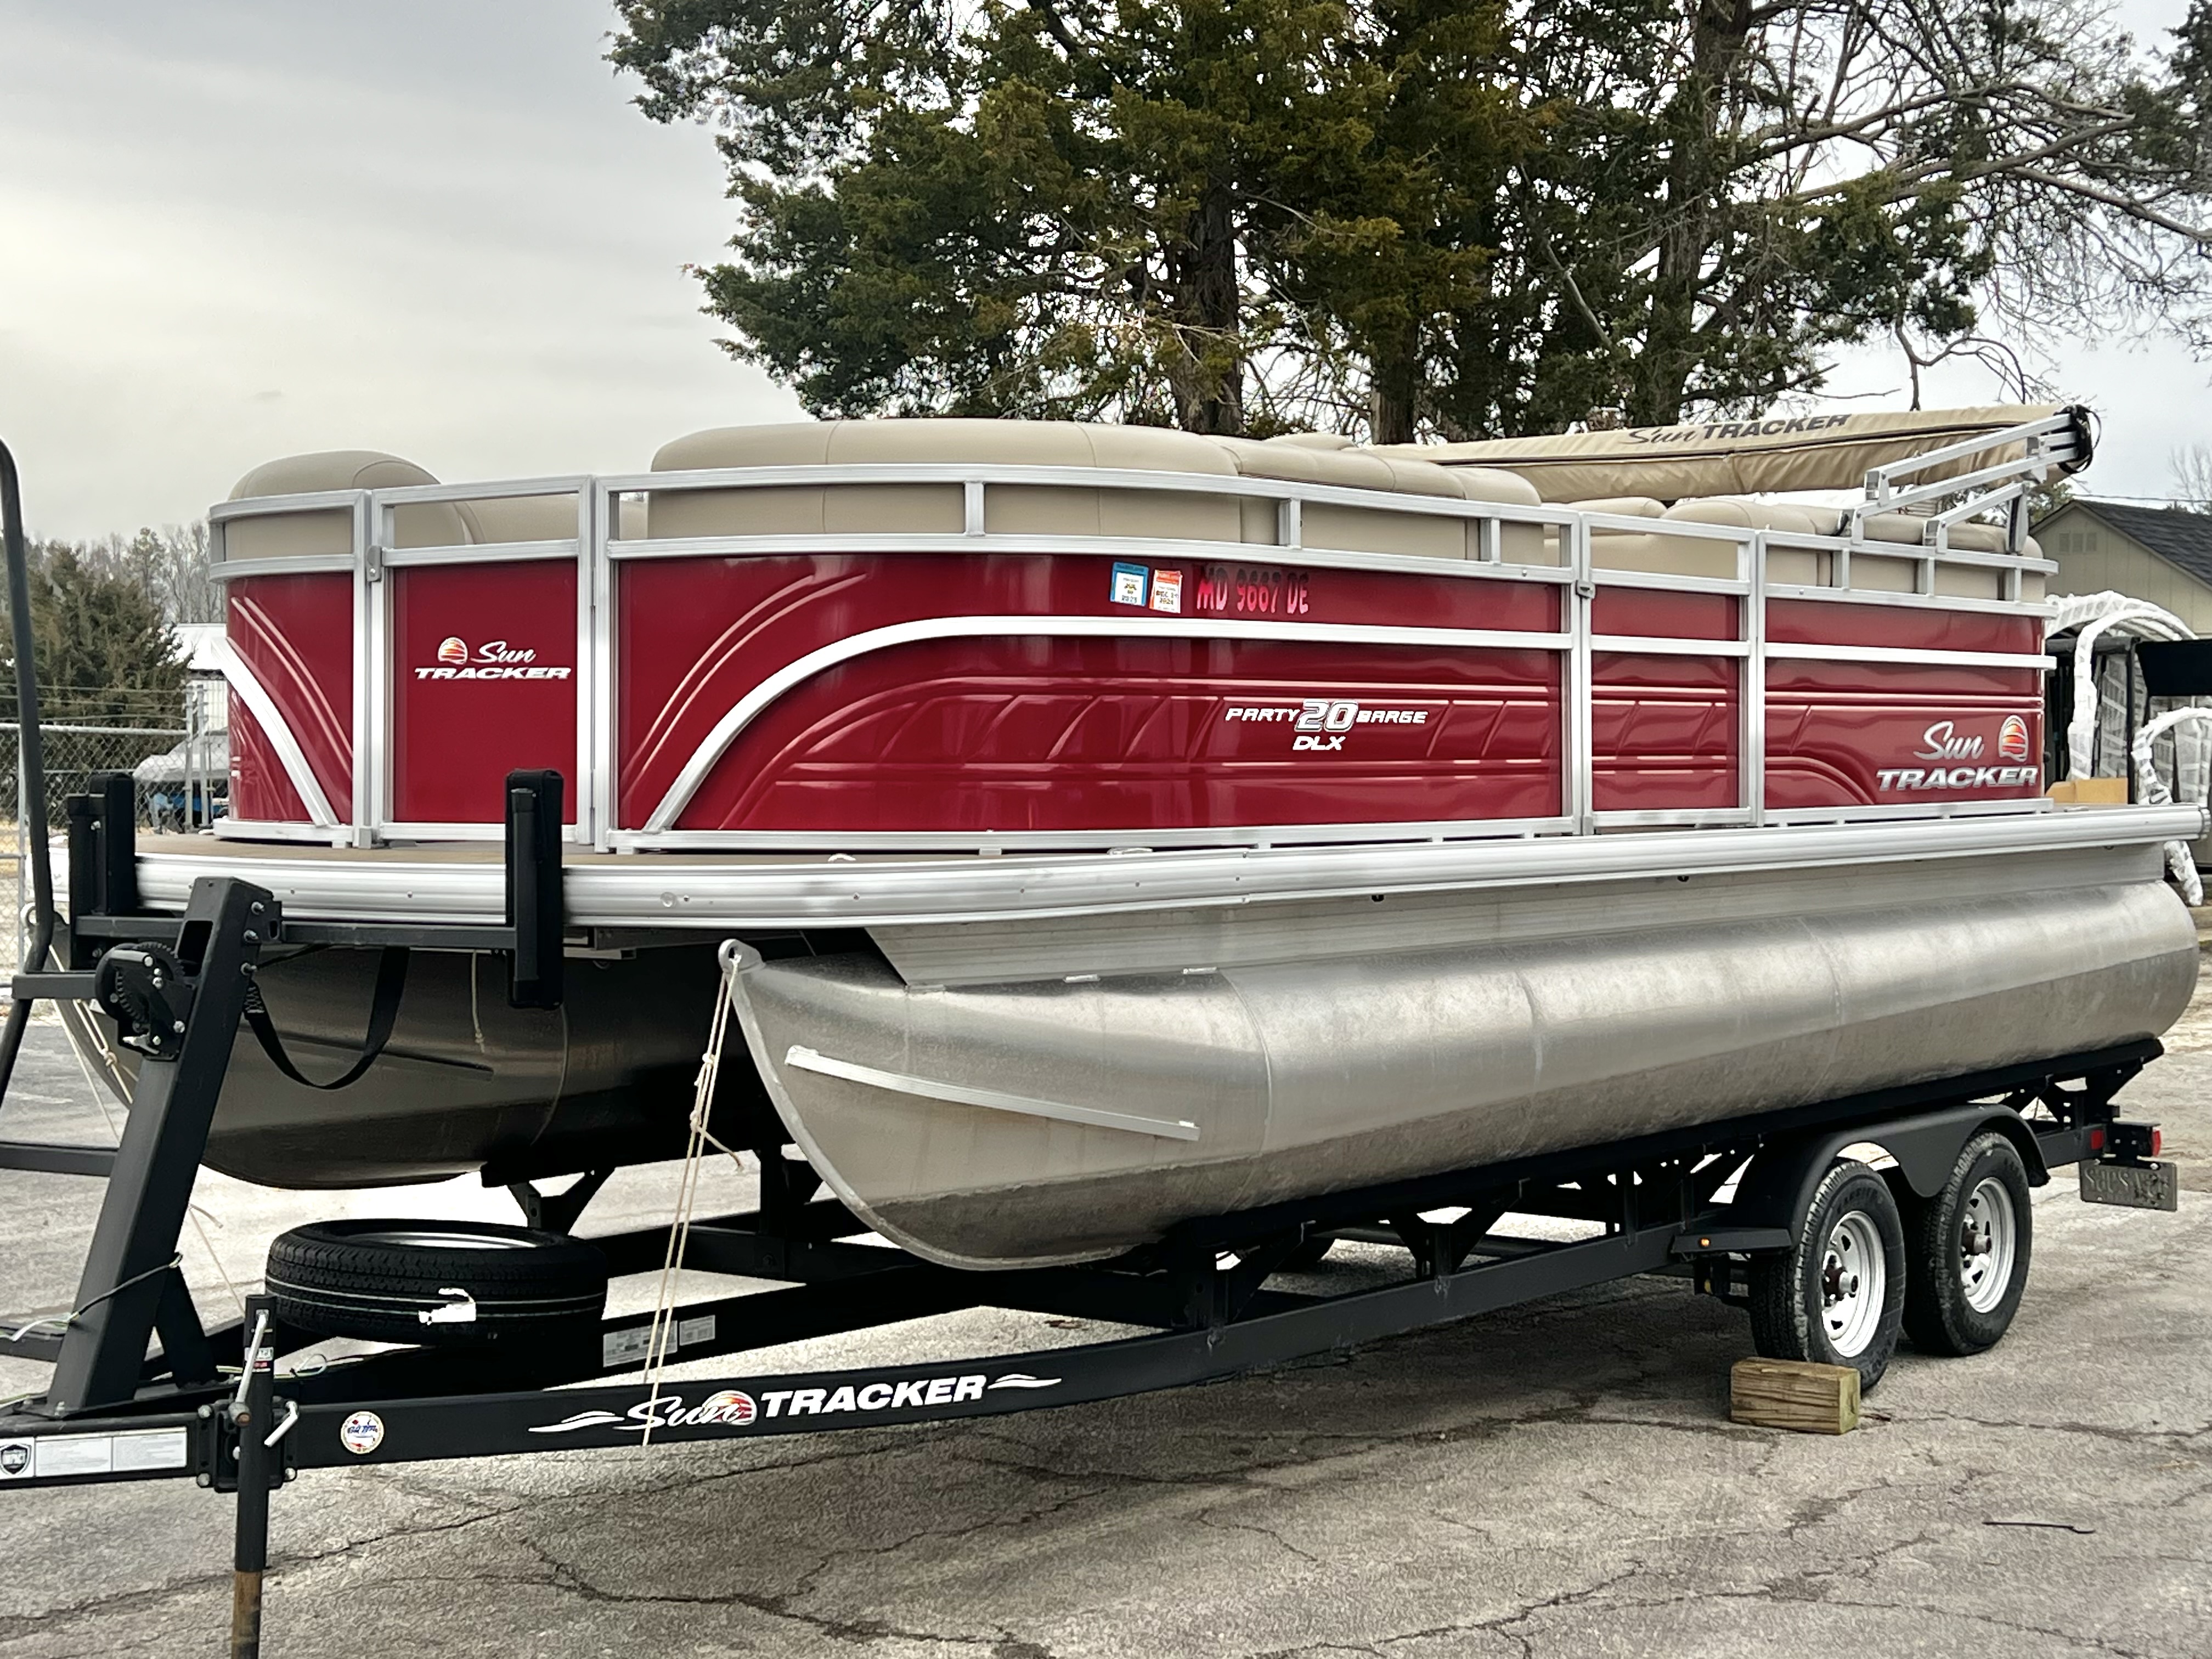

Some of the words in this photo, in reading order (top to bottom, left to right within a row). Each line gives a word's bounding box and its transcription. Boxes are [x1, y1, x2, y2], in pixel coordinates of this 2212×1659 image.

[1620, 427, 1697, 444] Sun
[1704, 414, 1852, 439] TRACKER
[1197, 566, 1227, 610] MD
[1287, 572, 1309, 614] DE
[470, 641, 537, 663] Sun
[414, 667, 571, 680] TRACKER
[1225, 708, 1300, 722] PARTY
[1294, 698, 1359, 732] 20
[1356, 710, 1429, 724] BARGE
[1293, 735, 1346, 751] DLX
[1912, 720, 1985, 760] Sun
[1876, 766, 2039, 792] TRACKER
[612, 1395, 743, 1430] Sun
[761, 1375, 988, 1418] TRACKER
